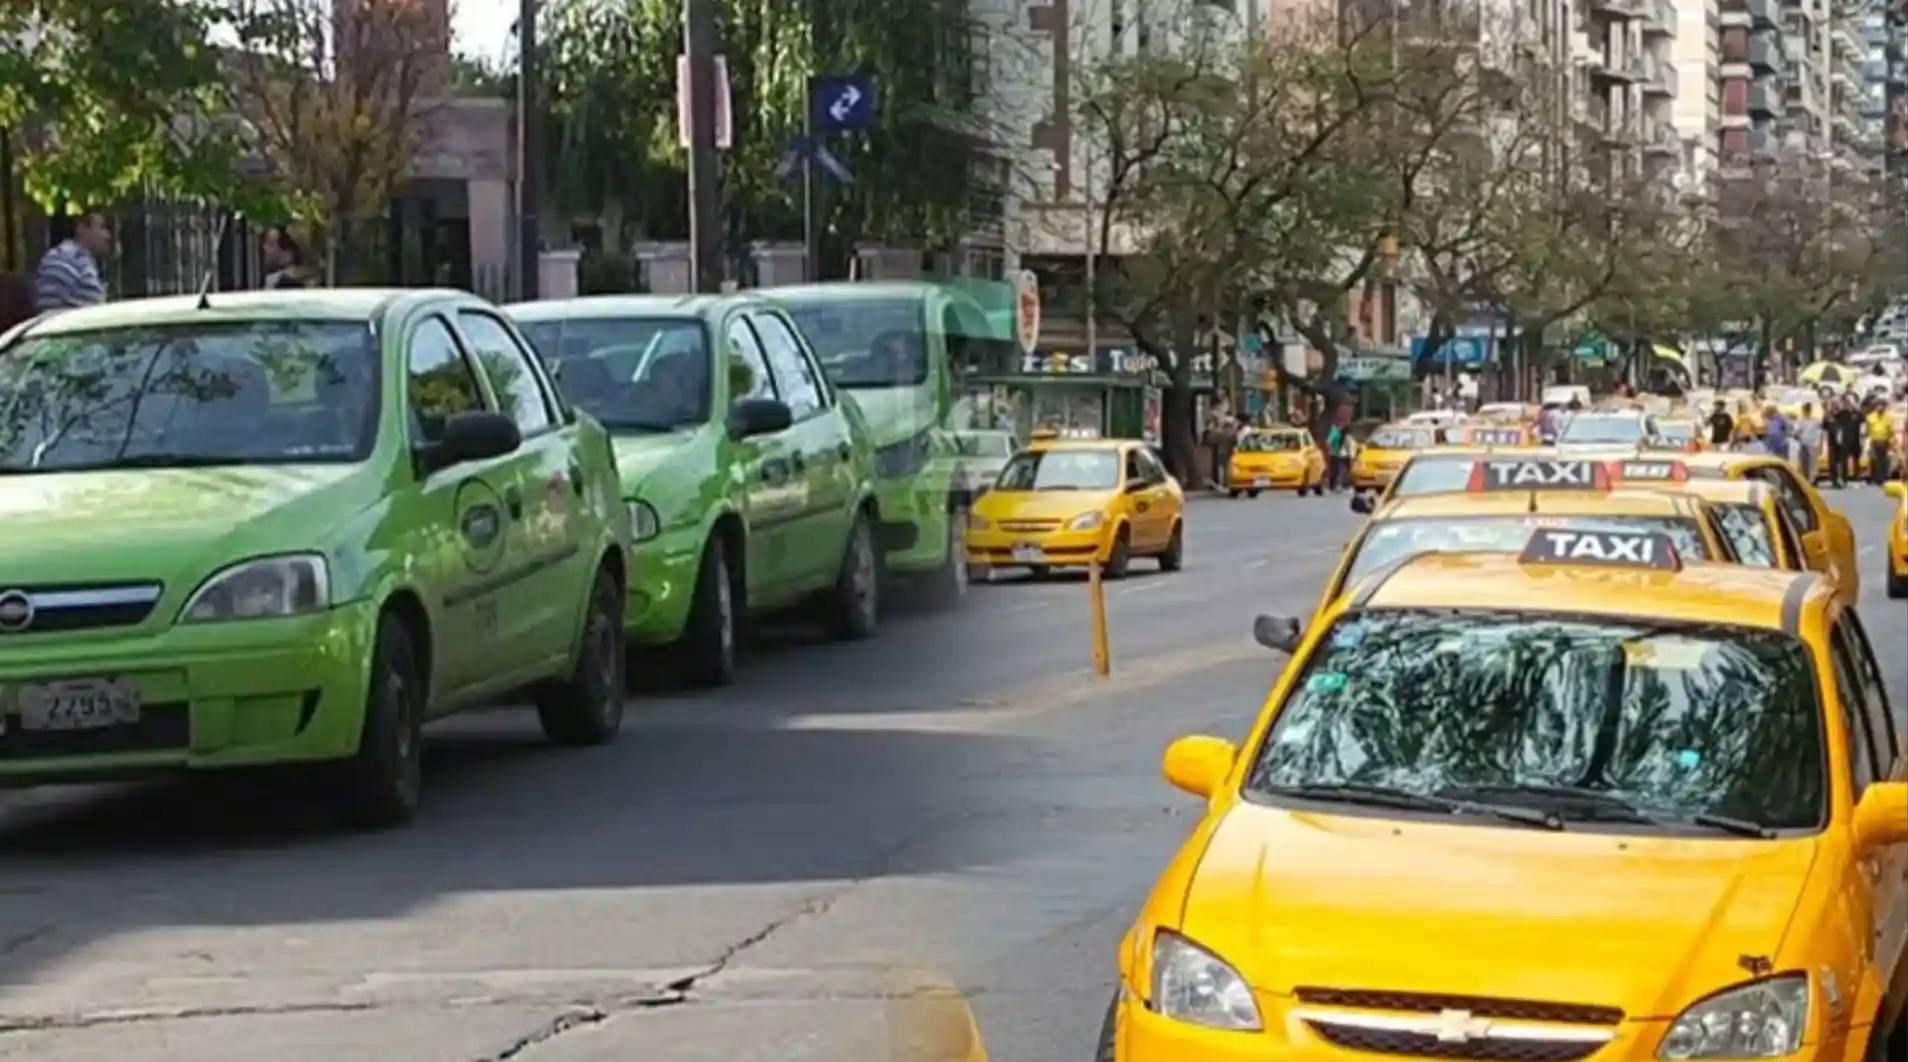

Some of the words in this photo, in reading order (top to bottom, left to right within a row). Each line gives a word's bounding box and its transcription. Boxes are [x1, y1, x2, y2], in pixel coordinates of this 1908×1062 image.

[1490, 462, 1591, 485] TAXI
[1623, 463, 1672, 479] TAXI
[1545, 532, 1655, 564] TAXI
